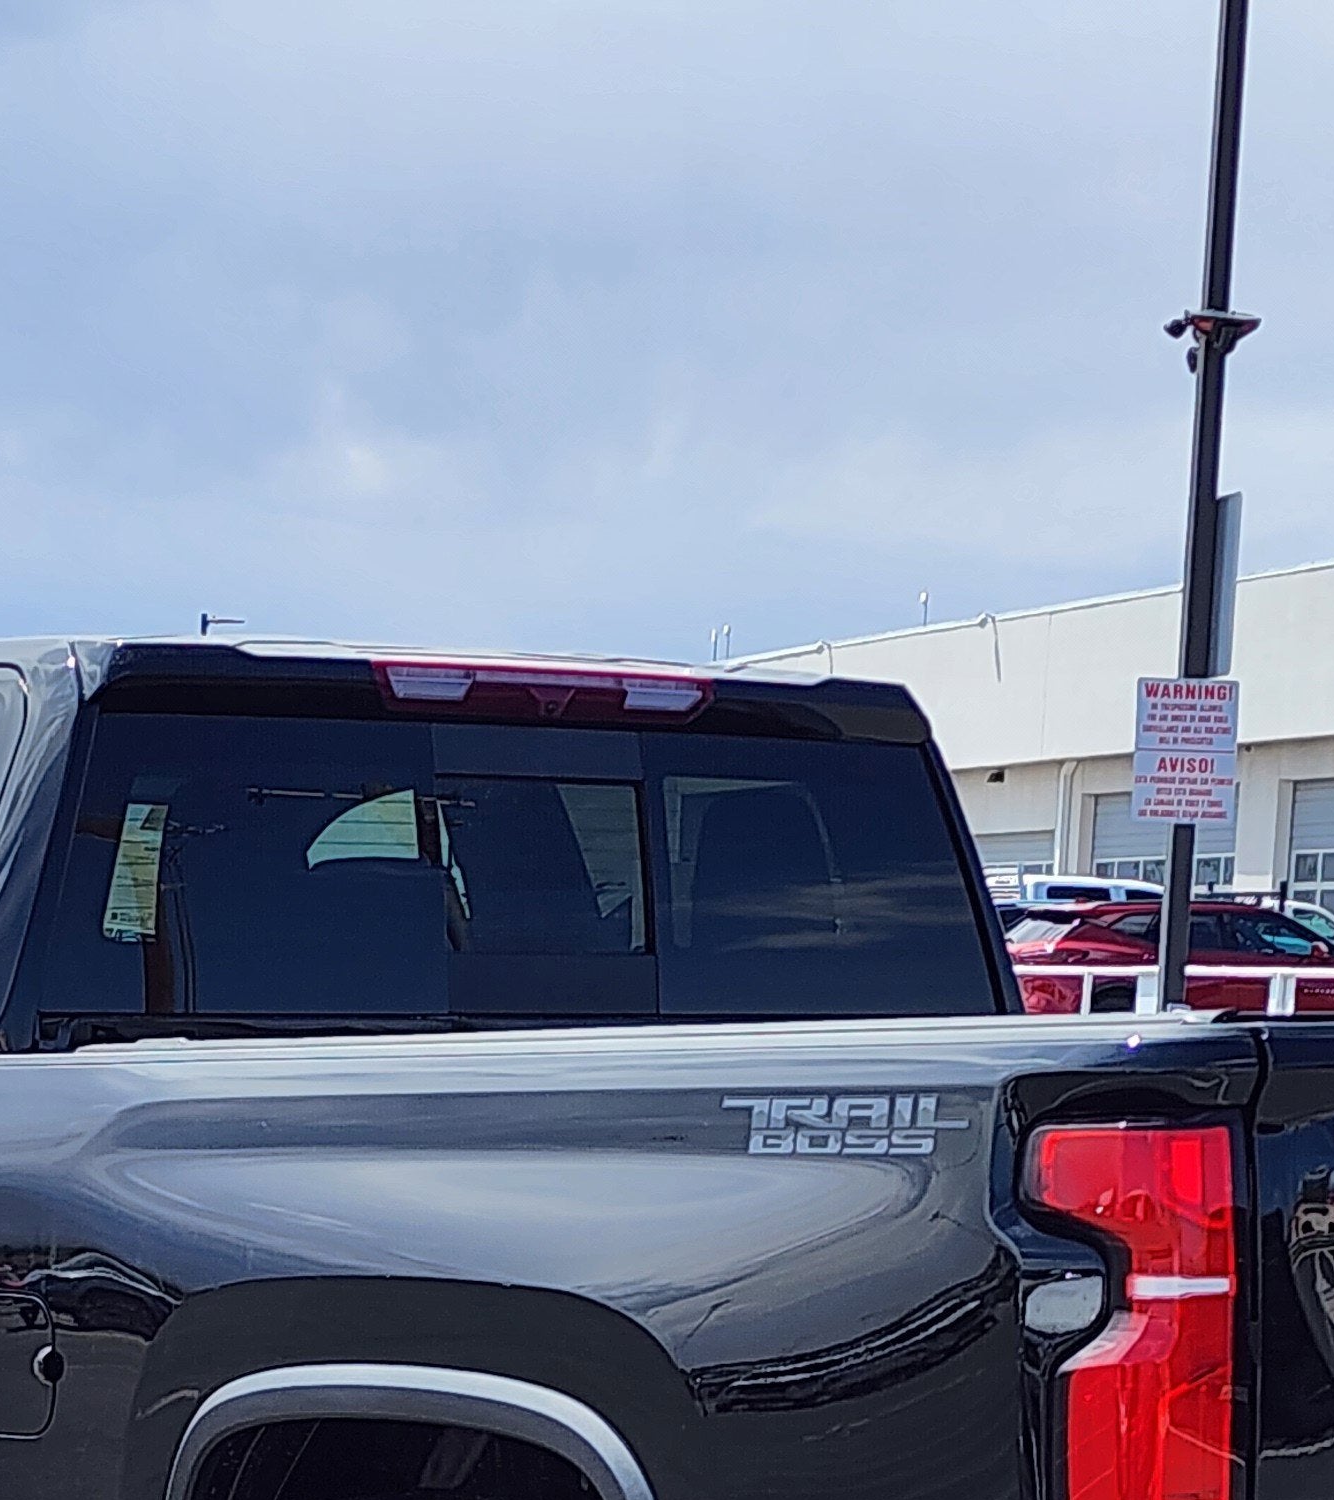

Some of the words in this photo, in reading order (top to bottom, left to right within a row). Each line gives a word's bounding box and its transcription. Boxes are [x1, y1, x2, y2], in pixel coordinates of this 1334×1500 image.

[1145, 683, 1233, 701] WARNING!
[1157, 757, 1215, 774] AVISO!
[721, 1094, 970, 1129] TRAIL
[748, 1130, 935, 1156] BOSS
